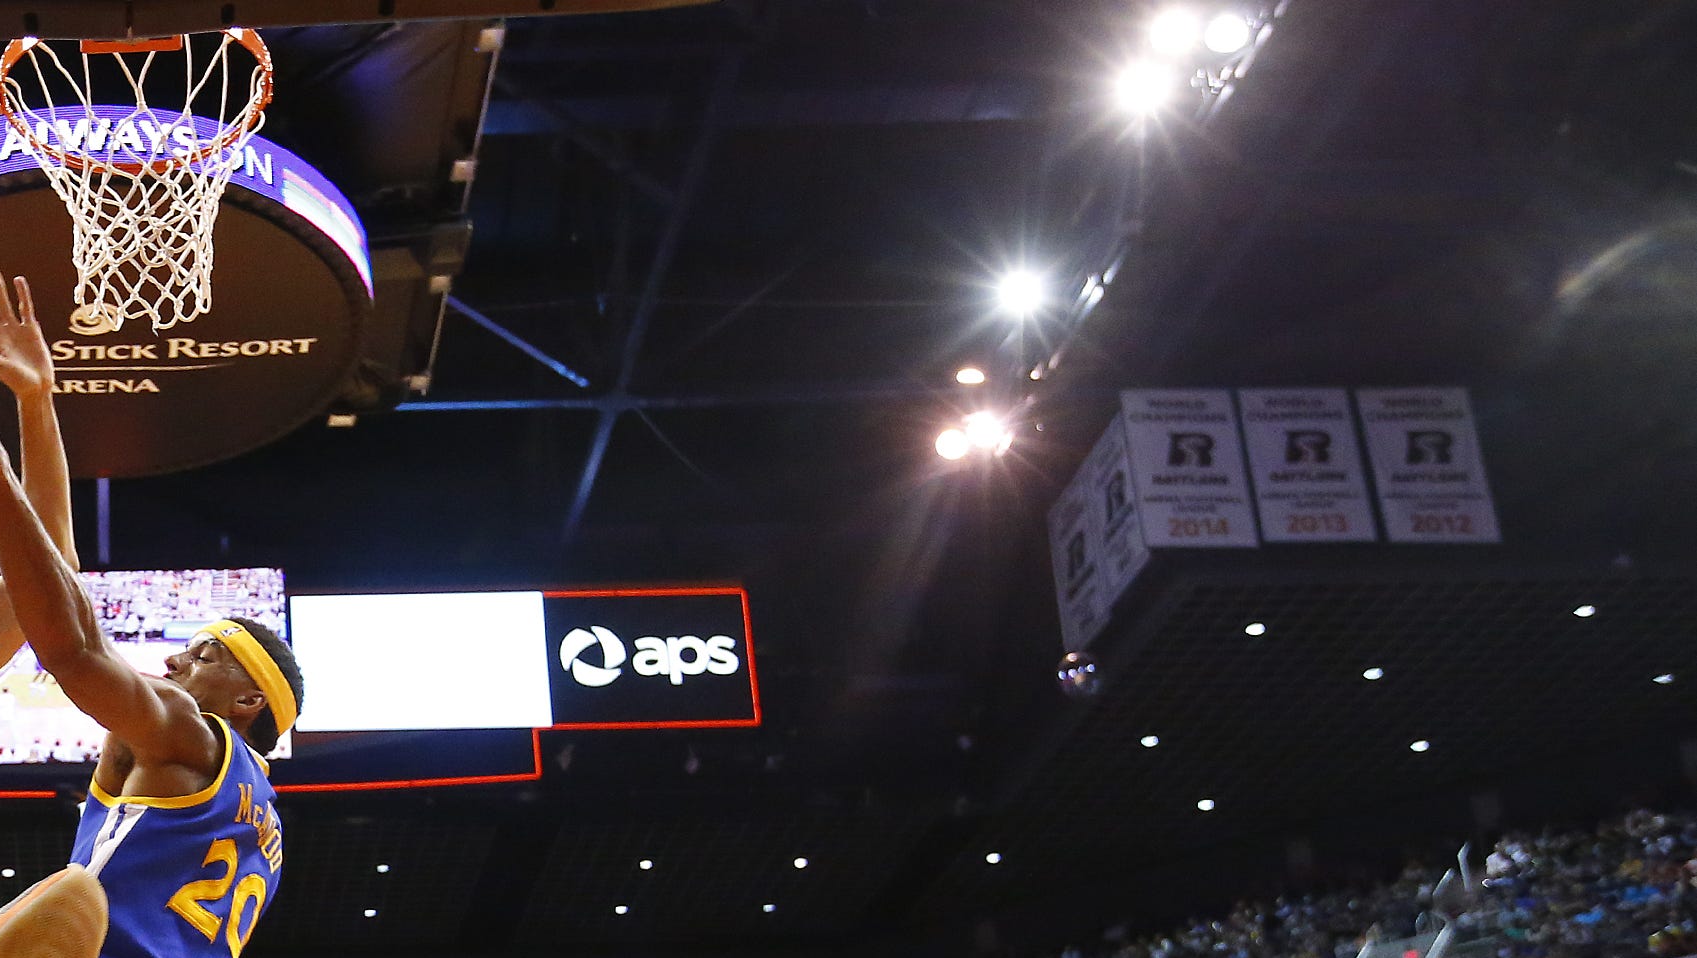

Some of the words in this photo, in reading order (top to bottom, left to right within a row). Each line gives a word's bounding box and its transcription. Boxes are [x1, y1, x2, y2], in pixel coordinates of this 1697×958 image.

[52, 339, 159, 361] STICK
[167, 337, 319, 360] RESORT
[1168, 518, 1229, 537] 2014
[1287, 513, 1350, 534] 2013
[1411, 513, 1474, 534] 2012
[632, 635, 739, 685] aps
